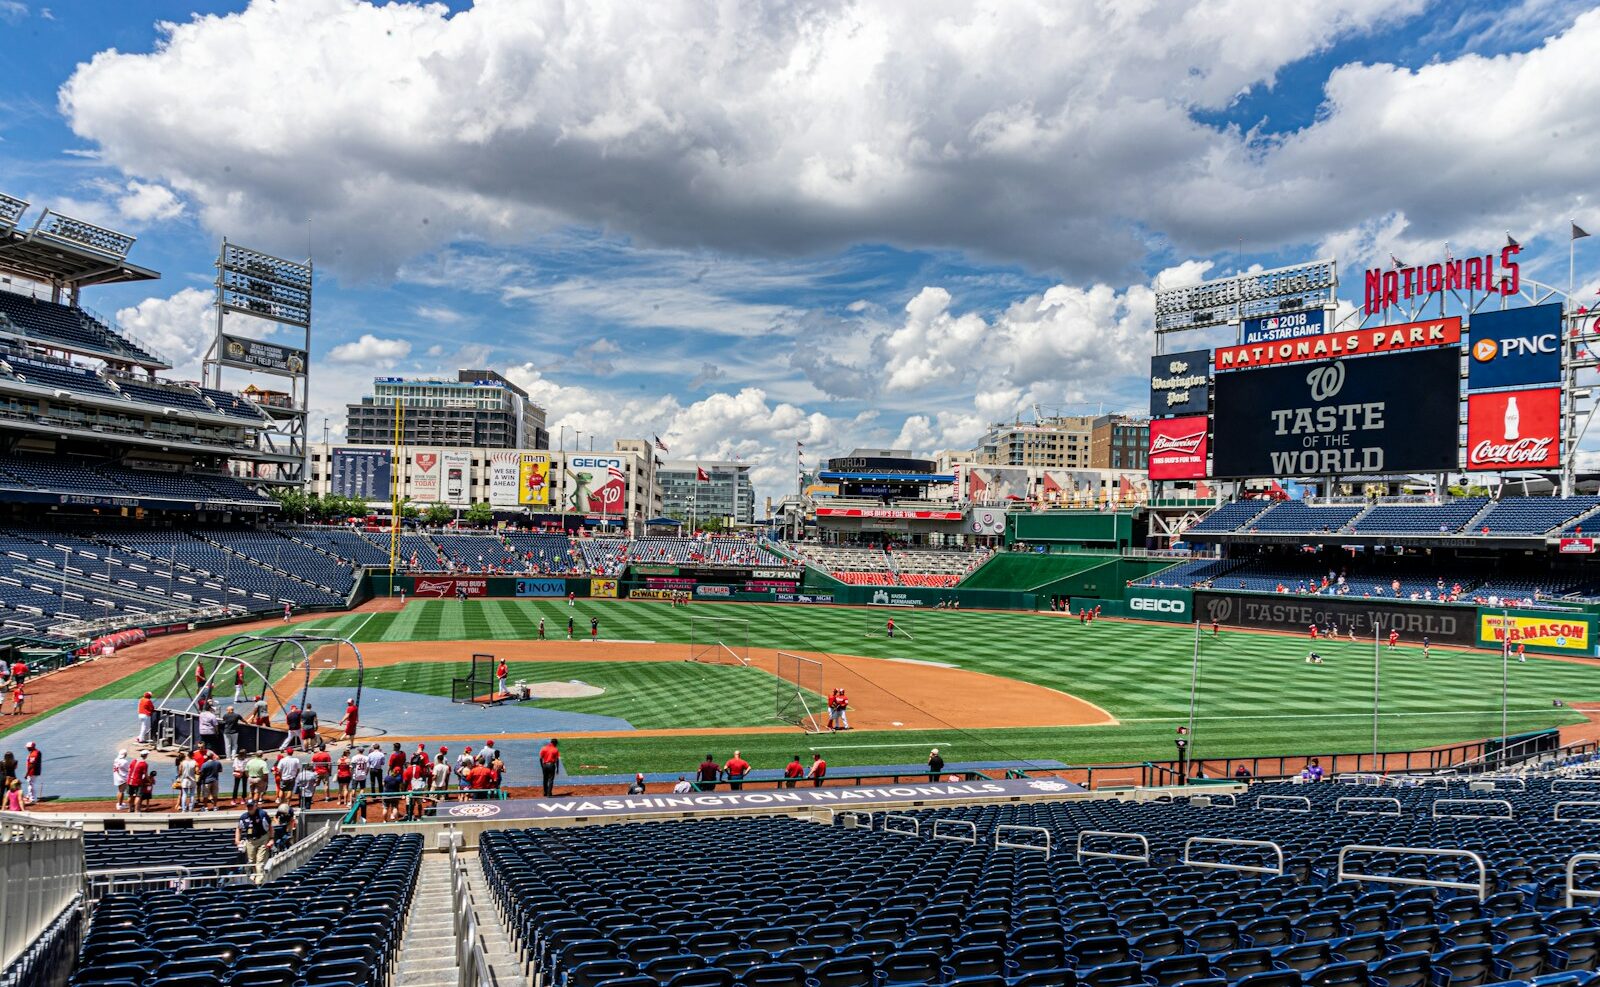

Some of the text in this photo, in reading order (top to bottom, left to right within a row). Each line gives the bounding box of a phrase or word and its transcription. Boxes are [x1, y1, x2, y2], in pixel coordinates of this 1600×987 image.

[1365, 244, 1520, 315] NATIONALS
[1280, 314, 1307, 328] 2018
[1292, 325, 1321, 337] GAME
[1221, 324, 1444, 365] NATIONALS PARK
[1500, 334, 1557, 357] PNC
[1169, 360, 1188, 374] The
[1152, 374, 1206, 390] Washington
[1167, 391, 1190, 407] Post
[1271, 402, 1385, 436] TASTE
[1154, 438, 1200, 449] Budweiser
[1302, 434, 1350, 448] OF THE
[1471, 437, 1553, 464] Coca-Cola
[573, 458, 620, 468] GEICO
[835, 458, 866, 468] WORLD
[1270, 447, 1384, 475] WORLD
[71, 496, 94, 504] TASTE
[112, 497, 139, 507] WORLD
[240, 505, 264, 513] WORLD
[1272, 536, 1300, 544] WORLD
[1389, 538, 1417, 546] TASTE
[1442, 538, 1476, 547] WORLD
[777, 571, 800, 579] FAN
[528, 583, 564, 593] INOVA
[1130, 597, 1185, 614] GEICO
[1246, 603, 1456, 635] TASTE OF THE WORLD
[1494, 624, 1584, 640] WB.MASON
[537, 783, 1006, 813] WASHINGTON NATIONALS
